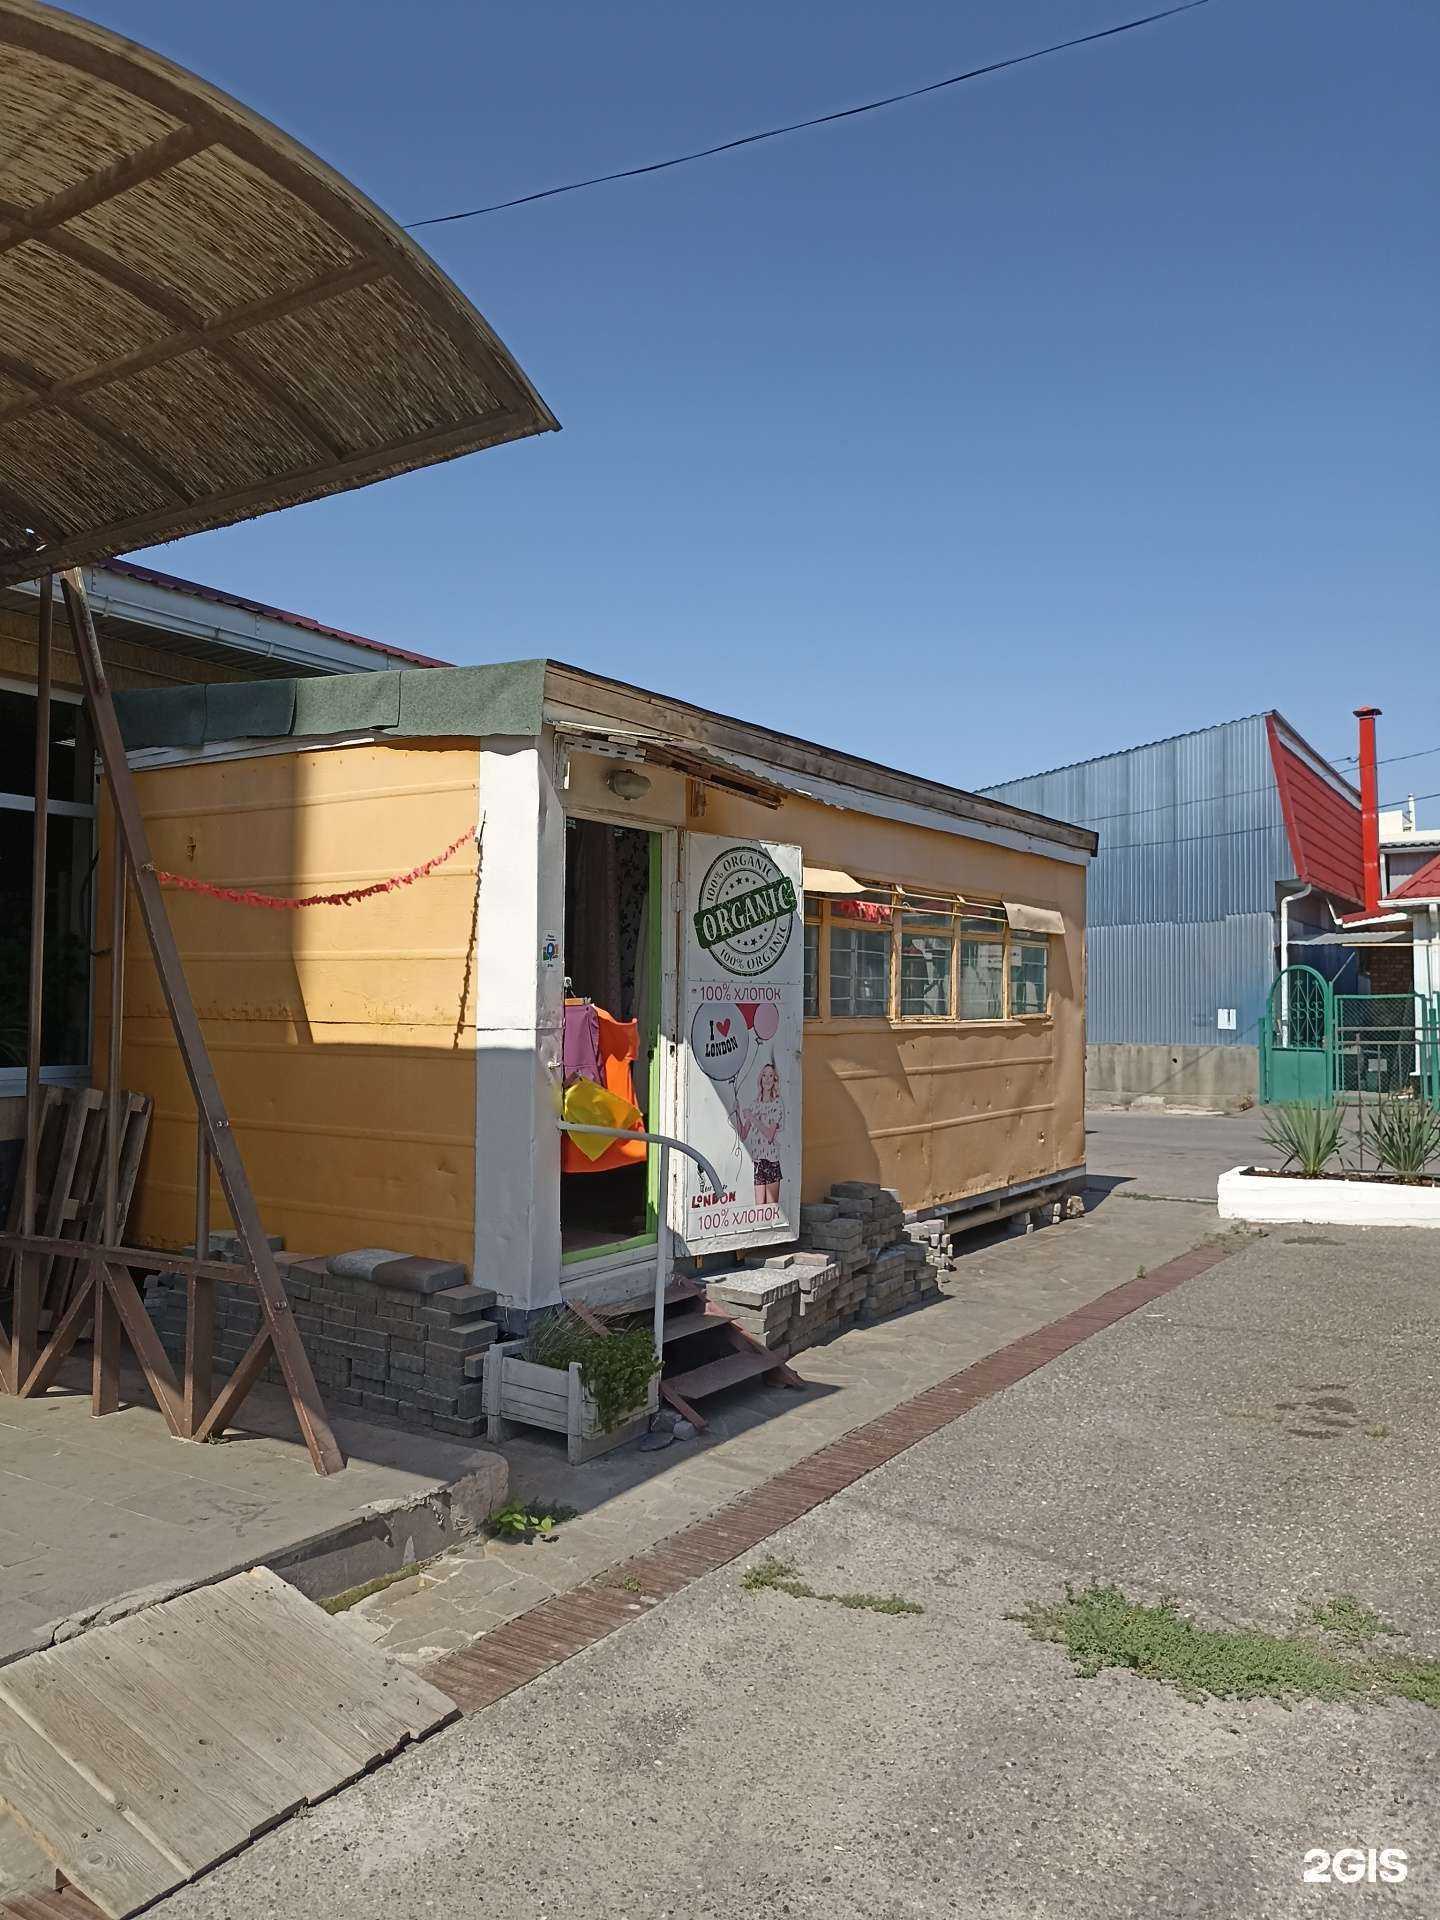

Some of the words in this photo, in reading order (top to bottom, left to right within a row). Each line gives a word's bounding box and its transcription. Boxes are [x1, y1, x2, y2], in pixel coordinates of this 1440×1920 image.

[706, 870, 724, 902] 100%
[722, 853, 775, 879] ORGANIC
[702, 882, 792, 942] ORGANIC
[719, 948, 745, 970] 100%
[746, 925, 788, 970] ORGANIC
[700, 983, 732, 1001] 100%
[734, 987, 782, 1001] ХЛОПОК
[709, 1020, 715, 1041] I
[705, 1036, 738, 1057] LONDON
[698, 1208, 730, 1231] 100%
[732, 1206, 781, 1226] ХЛОПОК
